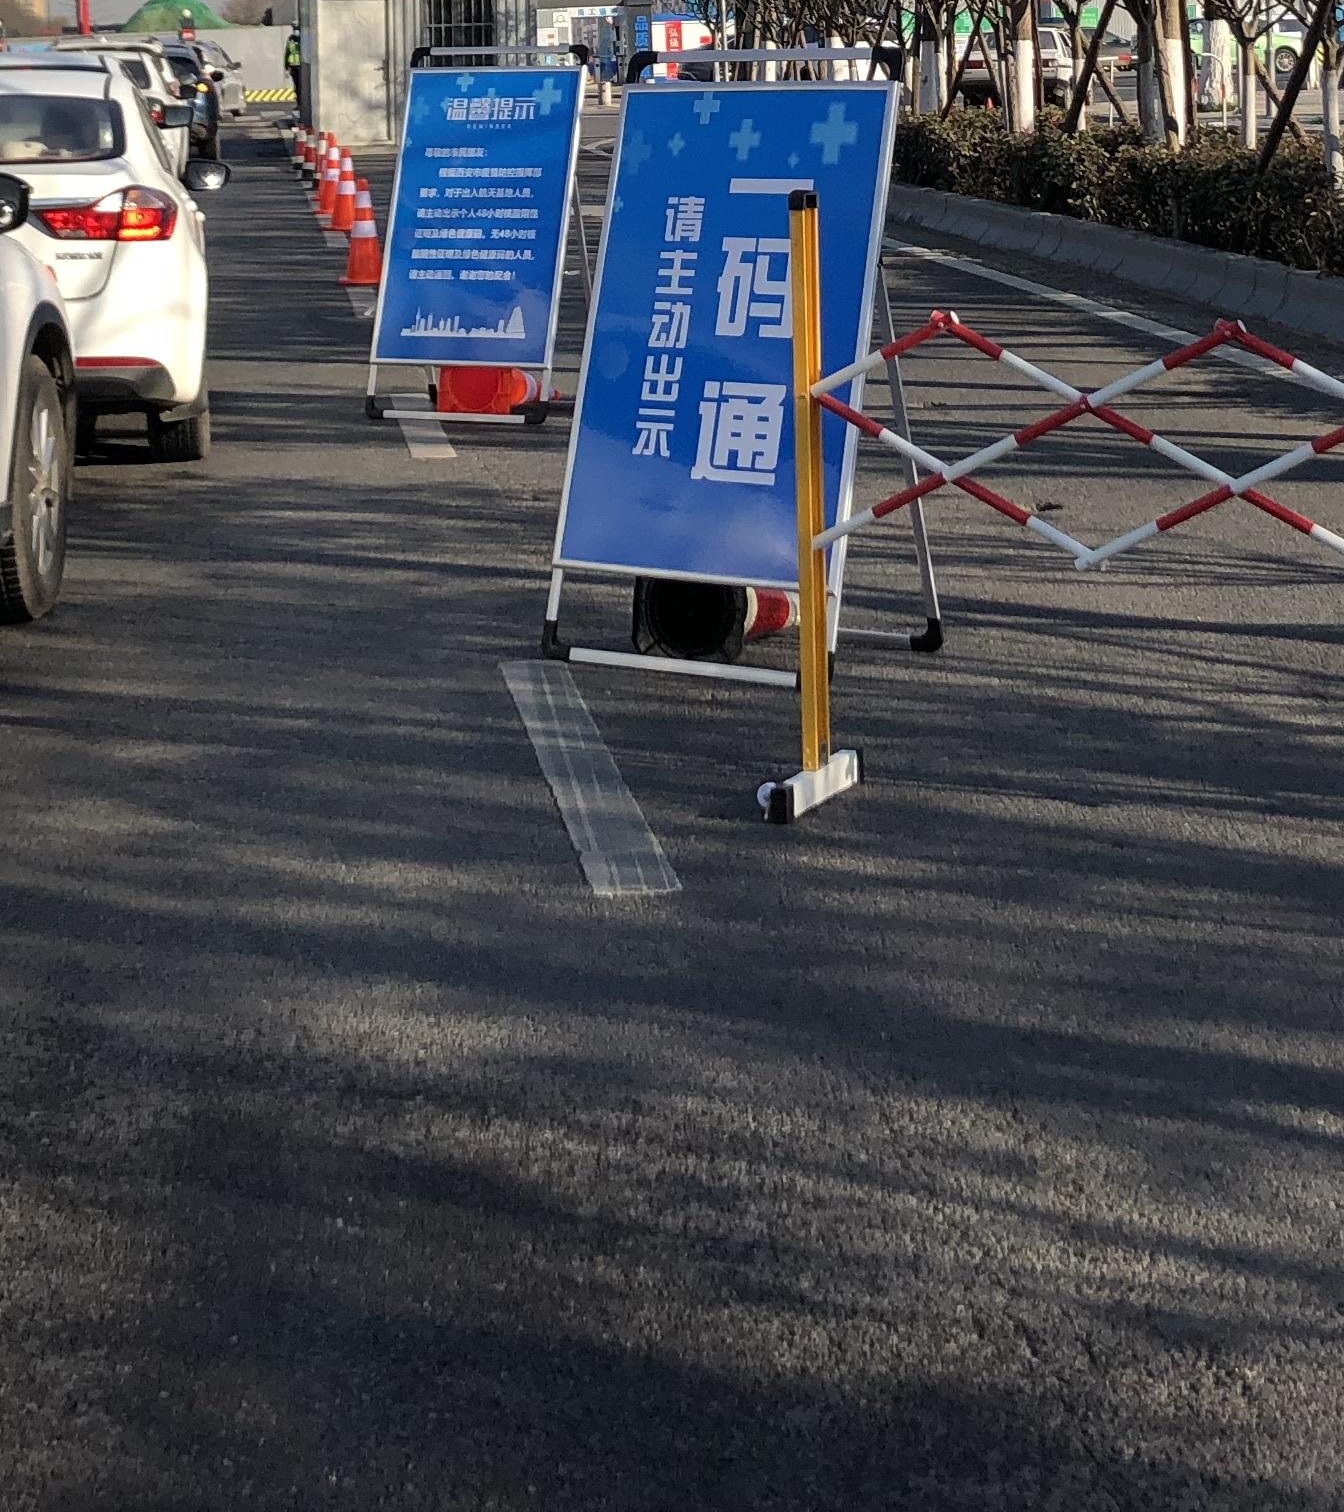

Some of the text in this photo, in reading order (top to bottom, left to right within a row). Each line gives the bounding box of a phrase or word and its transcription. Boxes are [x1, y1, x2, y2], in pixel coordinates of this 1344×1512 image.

[446, 97, 537, 121] 温馨提示
[632, 196, 705, 457] 请主动出示
[690, 178, 814, 486] 一码通
